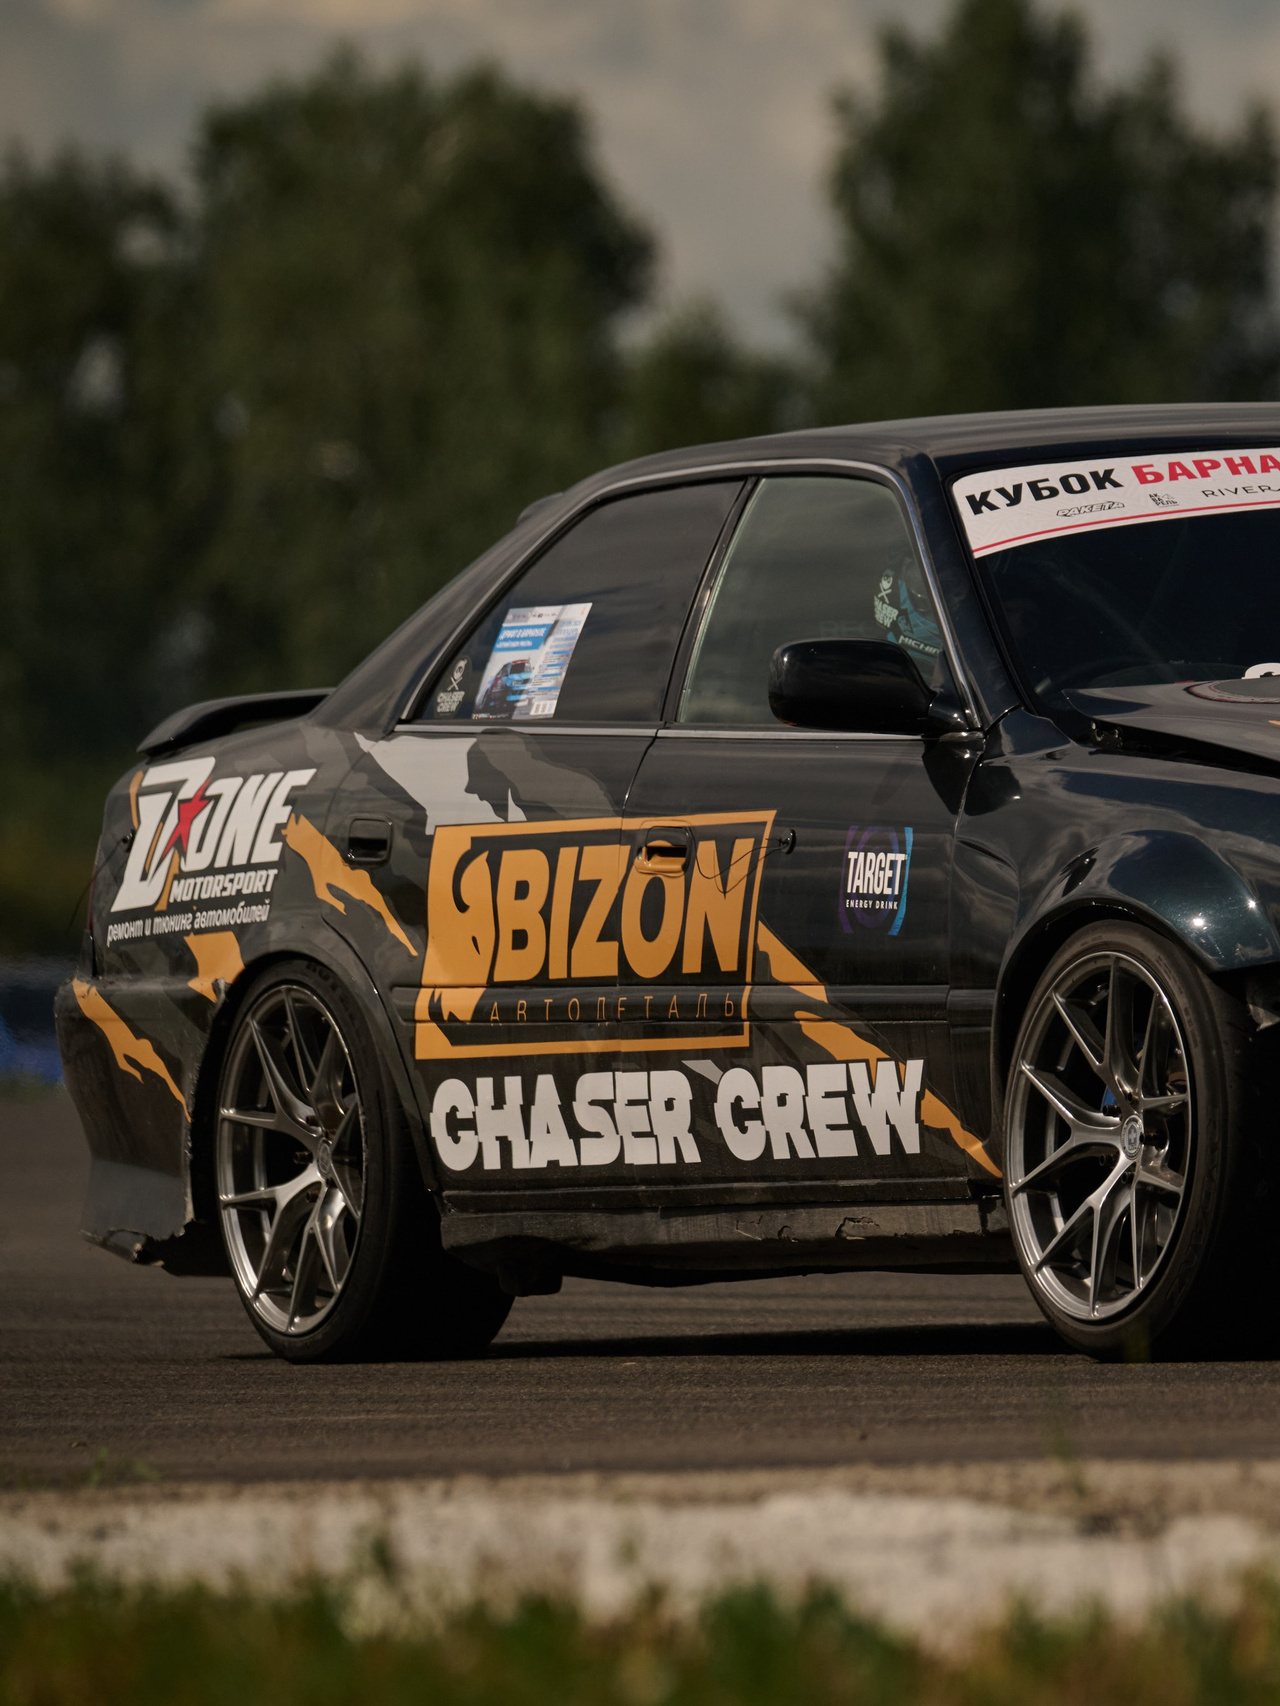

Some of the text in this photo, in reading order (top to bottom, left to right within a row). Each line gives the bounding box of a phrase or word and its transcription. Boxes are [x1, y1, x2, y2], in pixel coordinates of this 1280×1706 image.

[965, 468, 1124, 515] КУБОК
[1056, 500, 1126, 518] РАКЕТА
[1201, 485, 1280, 498] RIVER
[169, 868, 278, 903] MOTORSPORT
[847, 852, 907, 895] TARGET
[107, 899, 271, 948] ремонт и тюнинг автомобилей
[493, 836, 755, 983] BIZON
[846, 899, 899, 910] ENERGY DRINK
[430, 1058, 924, 1172] CHASER CREW
